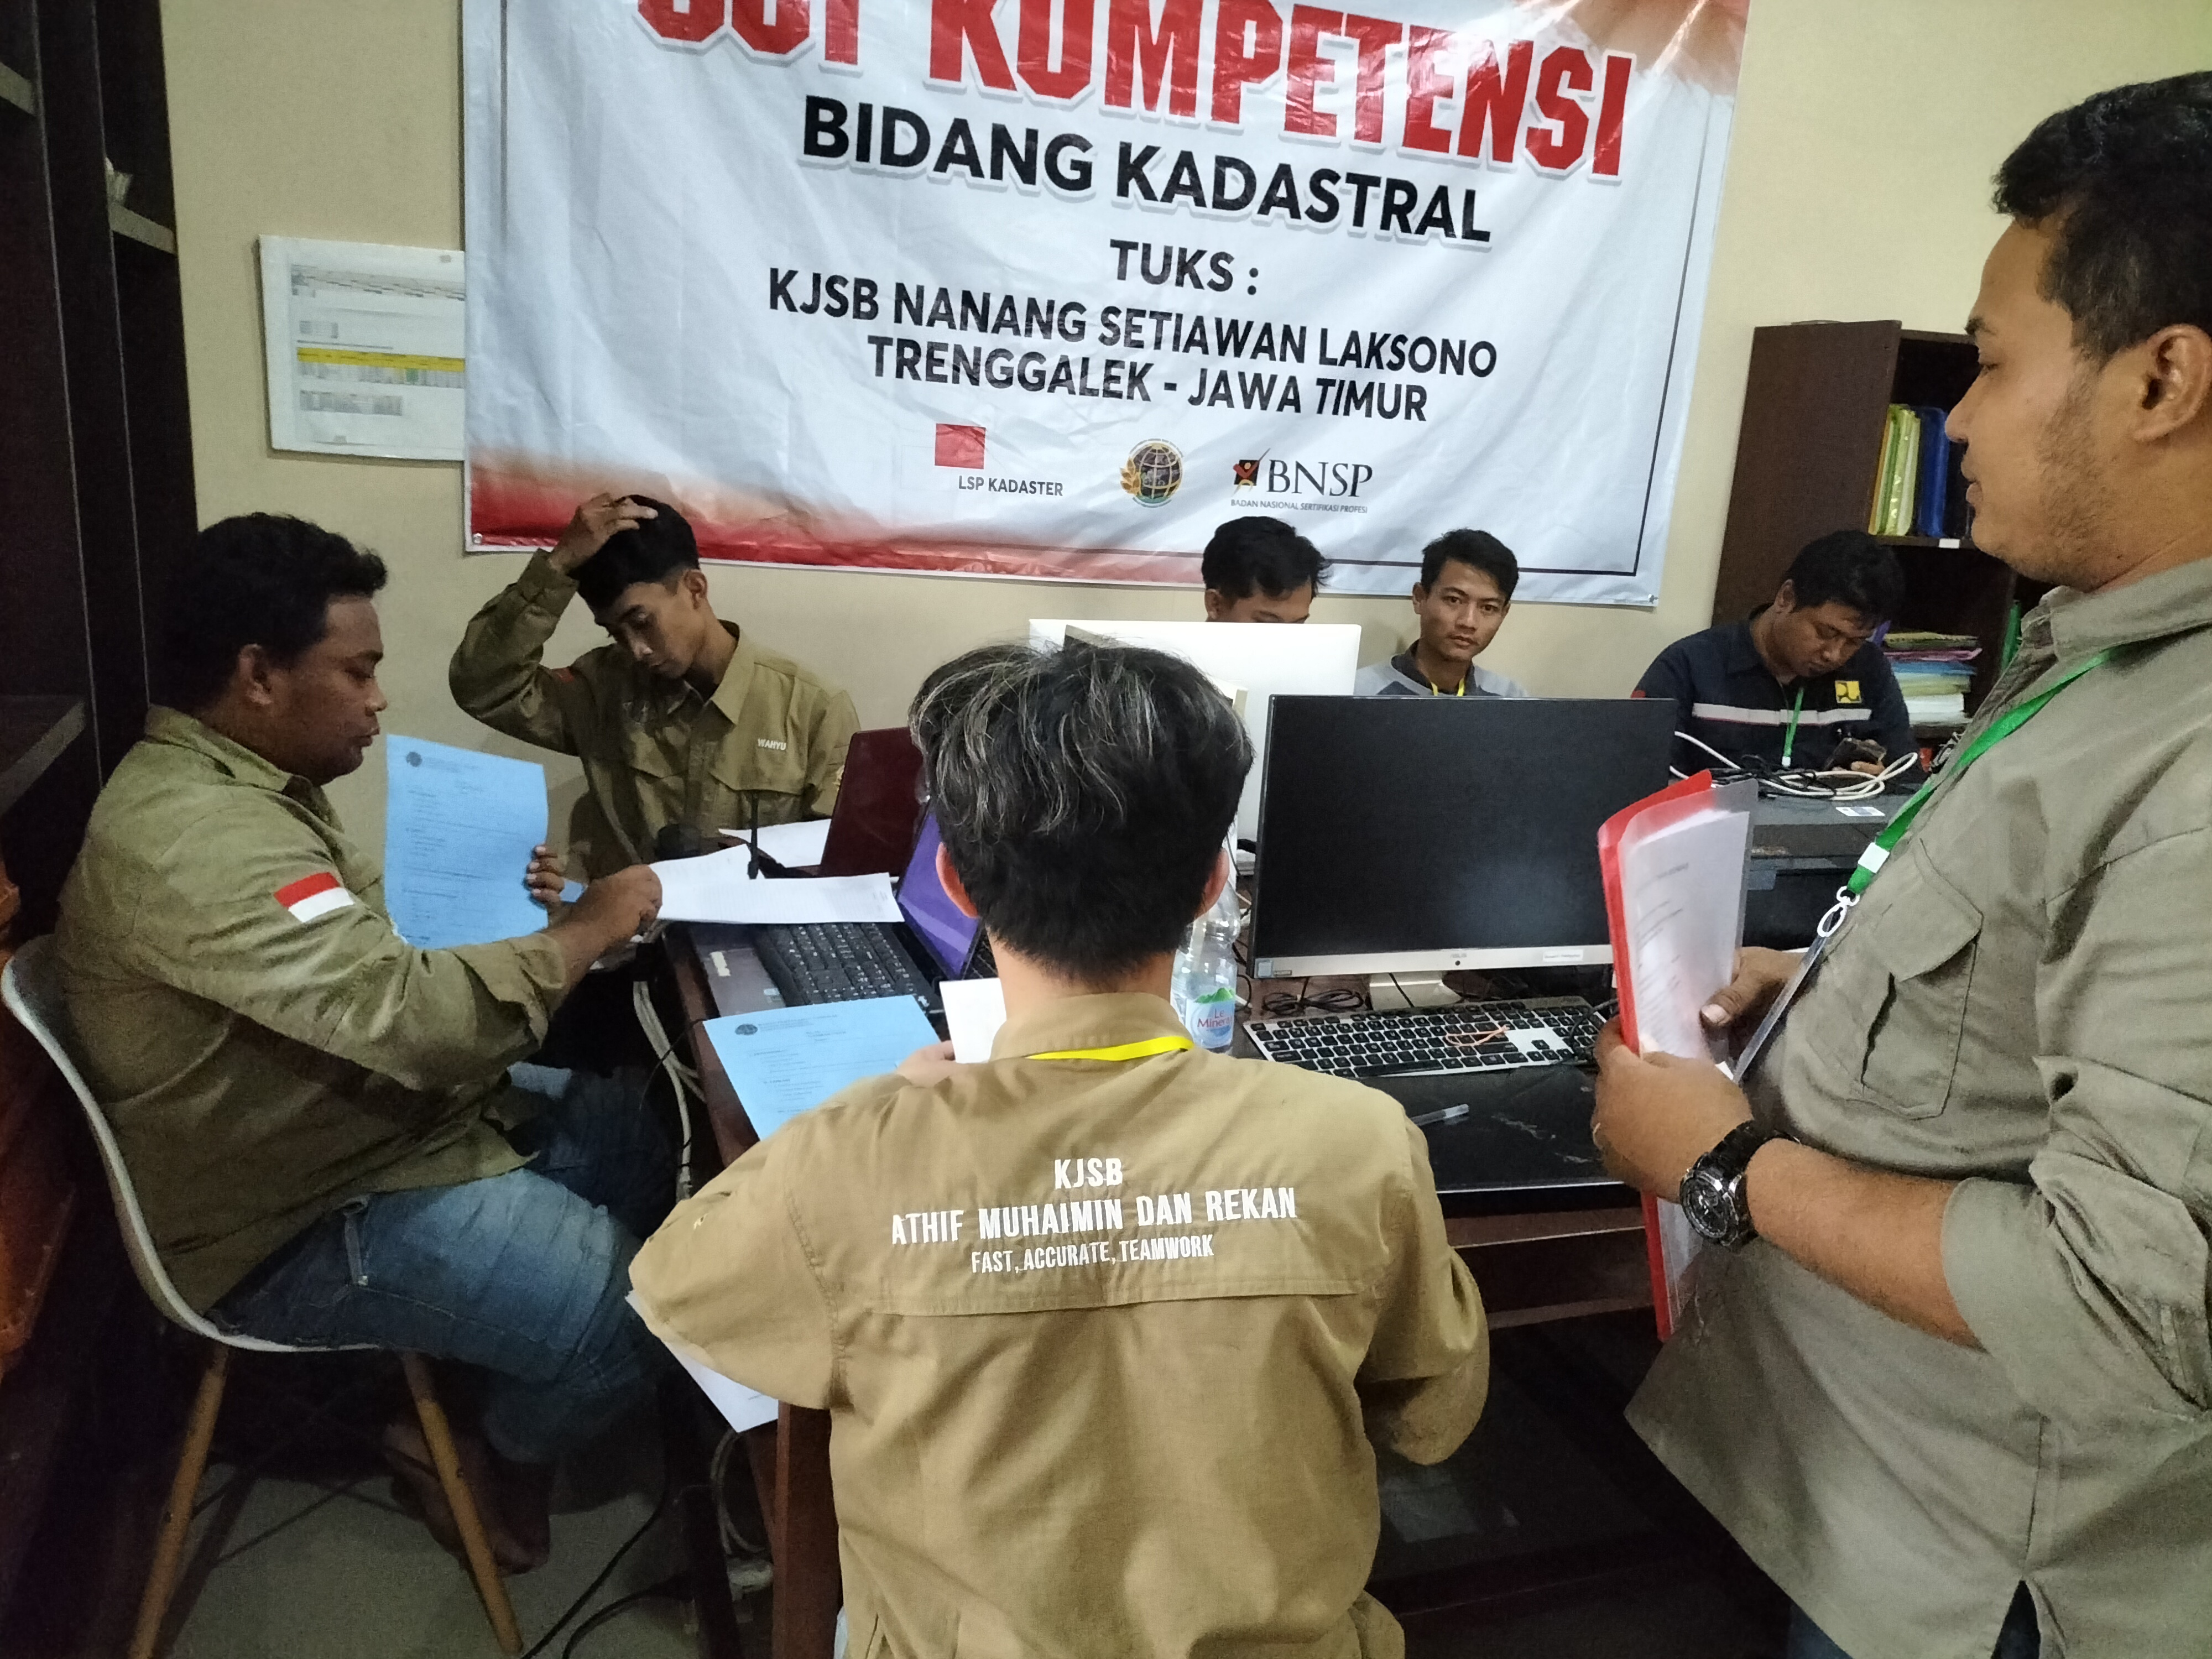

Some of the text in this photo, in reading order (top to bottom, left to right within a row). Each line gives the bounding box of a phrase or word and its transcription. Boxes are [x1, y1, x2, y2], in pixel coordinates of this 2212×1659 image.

[804, 95, 1491, 242] BIDANG KADASTRAL
[1110, 238, 1234, 291] TUKS
[769, 267, 1497, 377] KJSB NANANG SETIAWAN LAKSONO
[867, 335, 1154, 402] TRENGGALEK
[1188, 368, 1302, 413] JAWA
[1316, 378, 1427, 421] TIMUR
[958, 475, 1063, 496] LSP KADASTER
[1266, 459, 1373, 497] BNSP
[1231, 499, 1368, 513] BADAN NASIONAL SERTIFIKASI PROFESI
[758, 738, 786, 750] WAHYU
[1214, 1008, 1225, 1019] Le
[1055, 1158, 1123, 1189] KJSB
[891, 1187, 1296, 1245] ATHIF MUHAIMIN DAN REKAN
[1119, 1234, 1214, 1263] TEAMWORK
